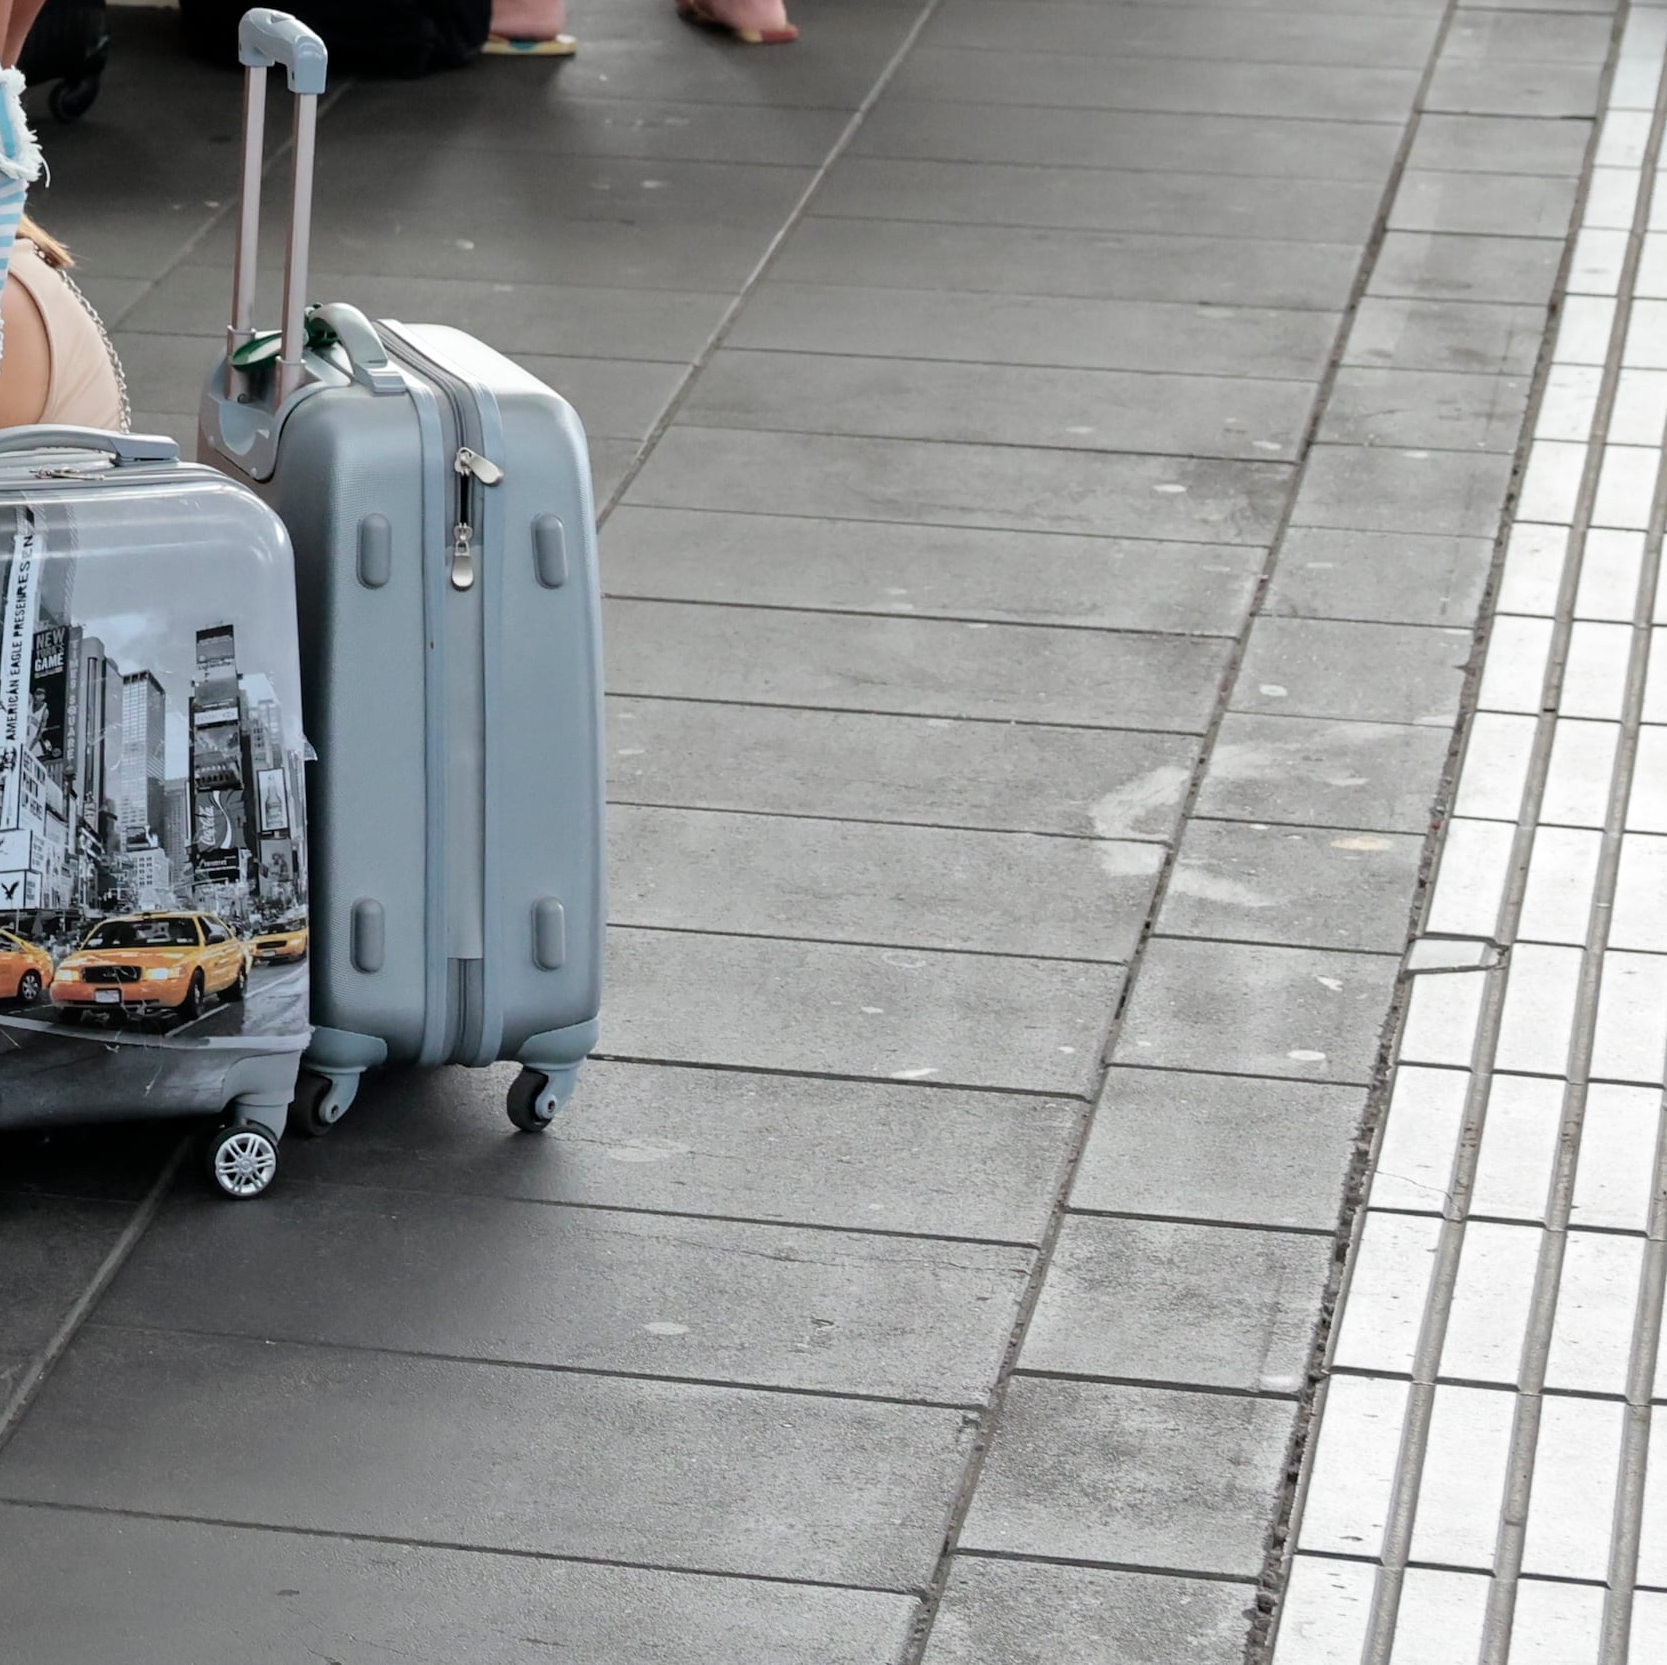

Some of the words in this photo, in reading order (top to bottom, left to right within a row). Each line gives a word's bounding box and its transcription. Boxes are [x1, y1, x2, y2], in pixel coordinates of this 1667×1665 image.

[36, 627, 65, 650] NEW
[11, 642, 22, 675] EAGLE
[34, 652, 64, 672] GAME
[5, 678, 19, 741] AMERICAN
[66, 695, 77, 761] SQUARE
